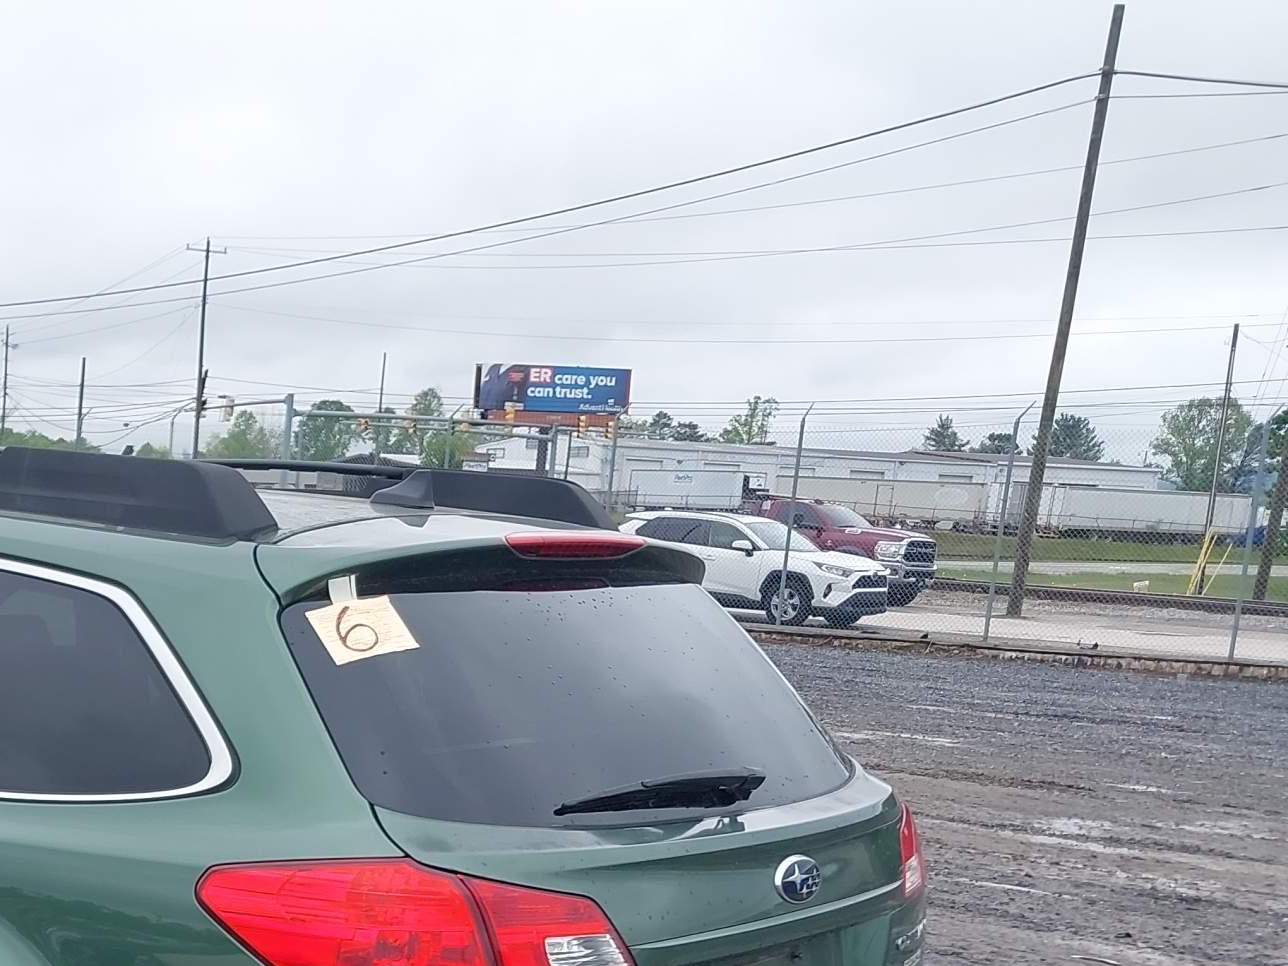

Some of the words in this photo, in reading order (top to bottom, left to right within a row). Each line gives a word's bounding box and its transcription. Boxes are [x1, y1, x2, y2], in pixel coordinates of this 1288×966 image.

[529, 368, 552, 383] ER
[554, 373, 585, 384] care
[589, 375, 616, 386] you
[527, 386, 553, 398] can
[555, 387, 592, 399] trust.
[335, 605, 379, 652] 6
